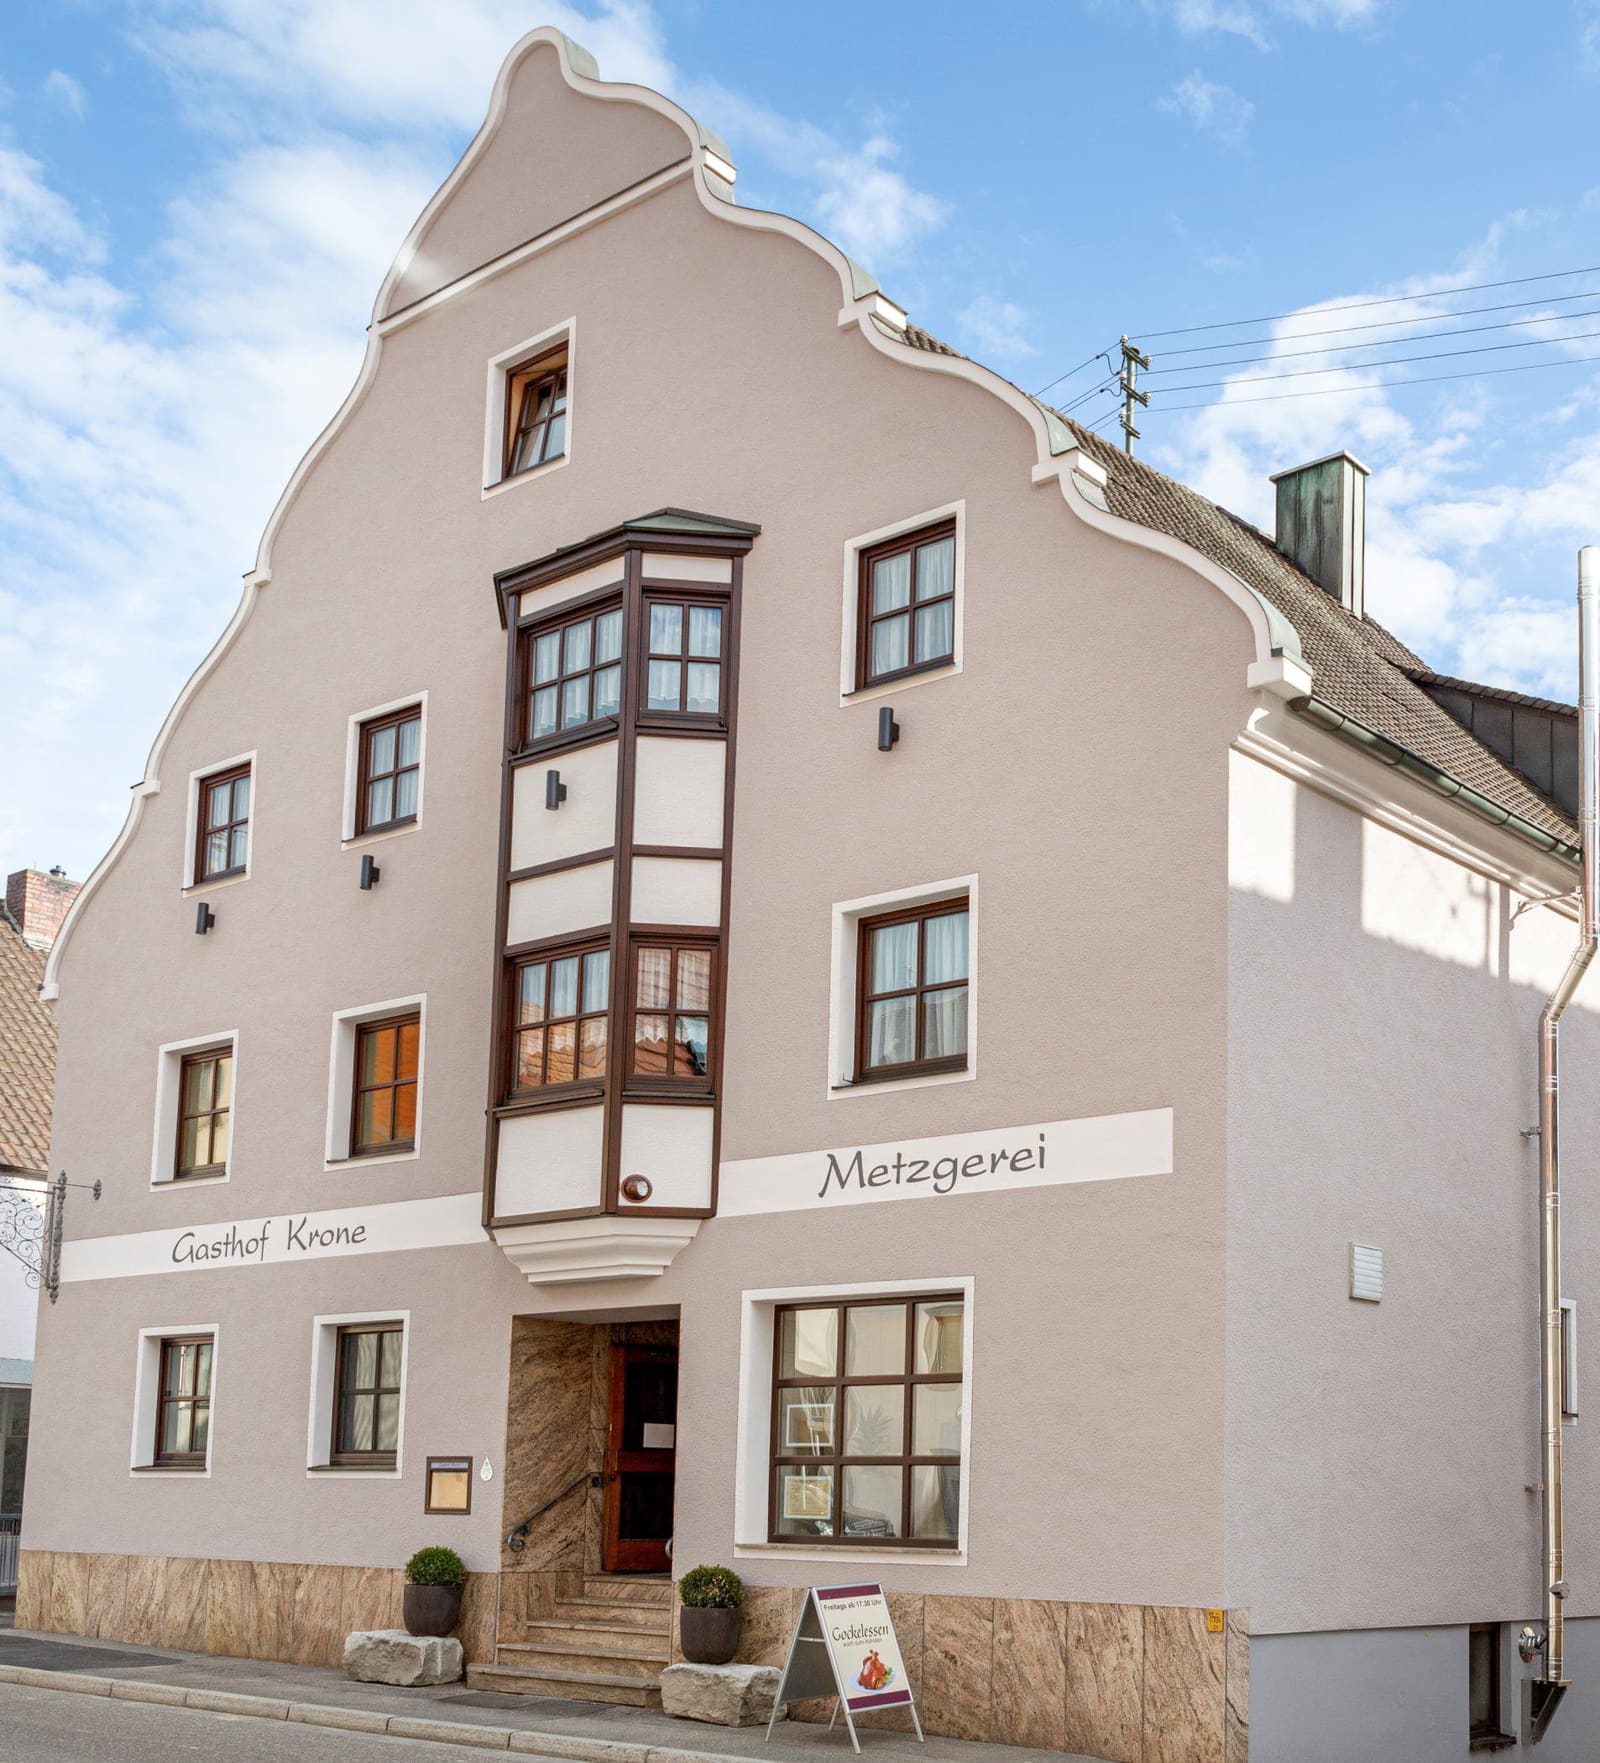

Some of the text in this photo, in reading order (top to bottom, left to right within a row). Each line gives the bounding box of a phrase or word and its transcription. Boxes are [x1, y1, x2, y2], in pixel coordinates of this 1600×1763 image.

[818, 1133, 1045, 1194] Metzgerei
[172, 1216, 367, 1263] Gasthof Krone
[832, 1624, 888, 1641] Gockelessen
